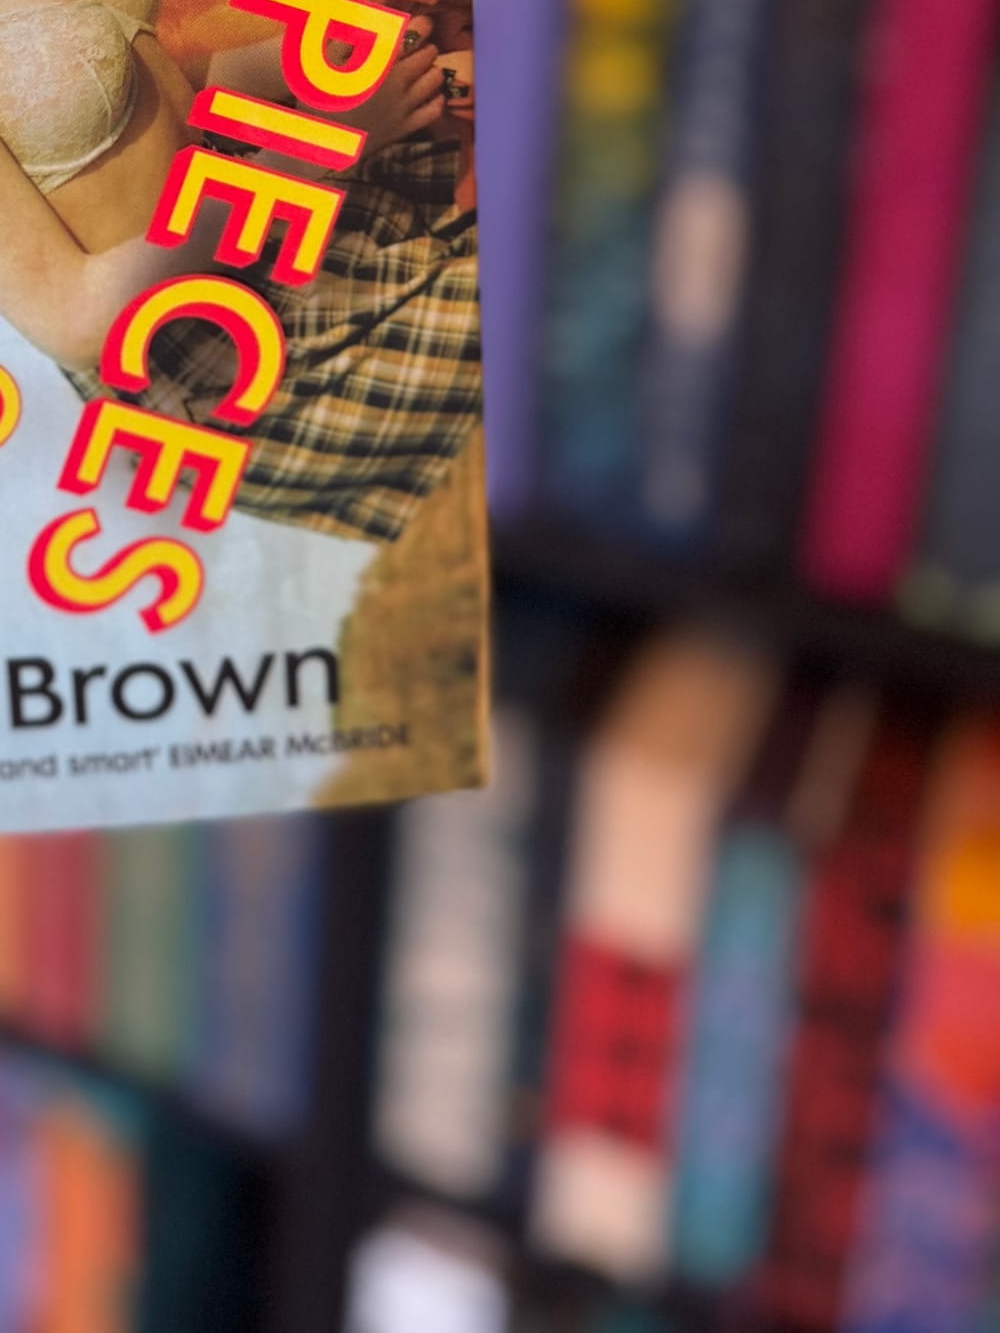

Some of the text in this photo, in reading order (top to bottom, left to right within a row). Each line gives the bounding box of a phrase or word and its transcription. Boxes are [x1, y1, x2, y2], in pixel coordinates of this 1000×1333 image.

[5, 647, 340, 730] Brown
[168, 735, 276, 769] EIMEAR
[285, 722, 410, 758] McBRIDE
